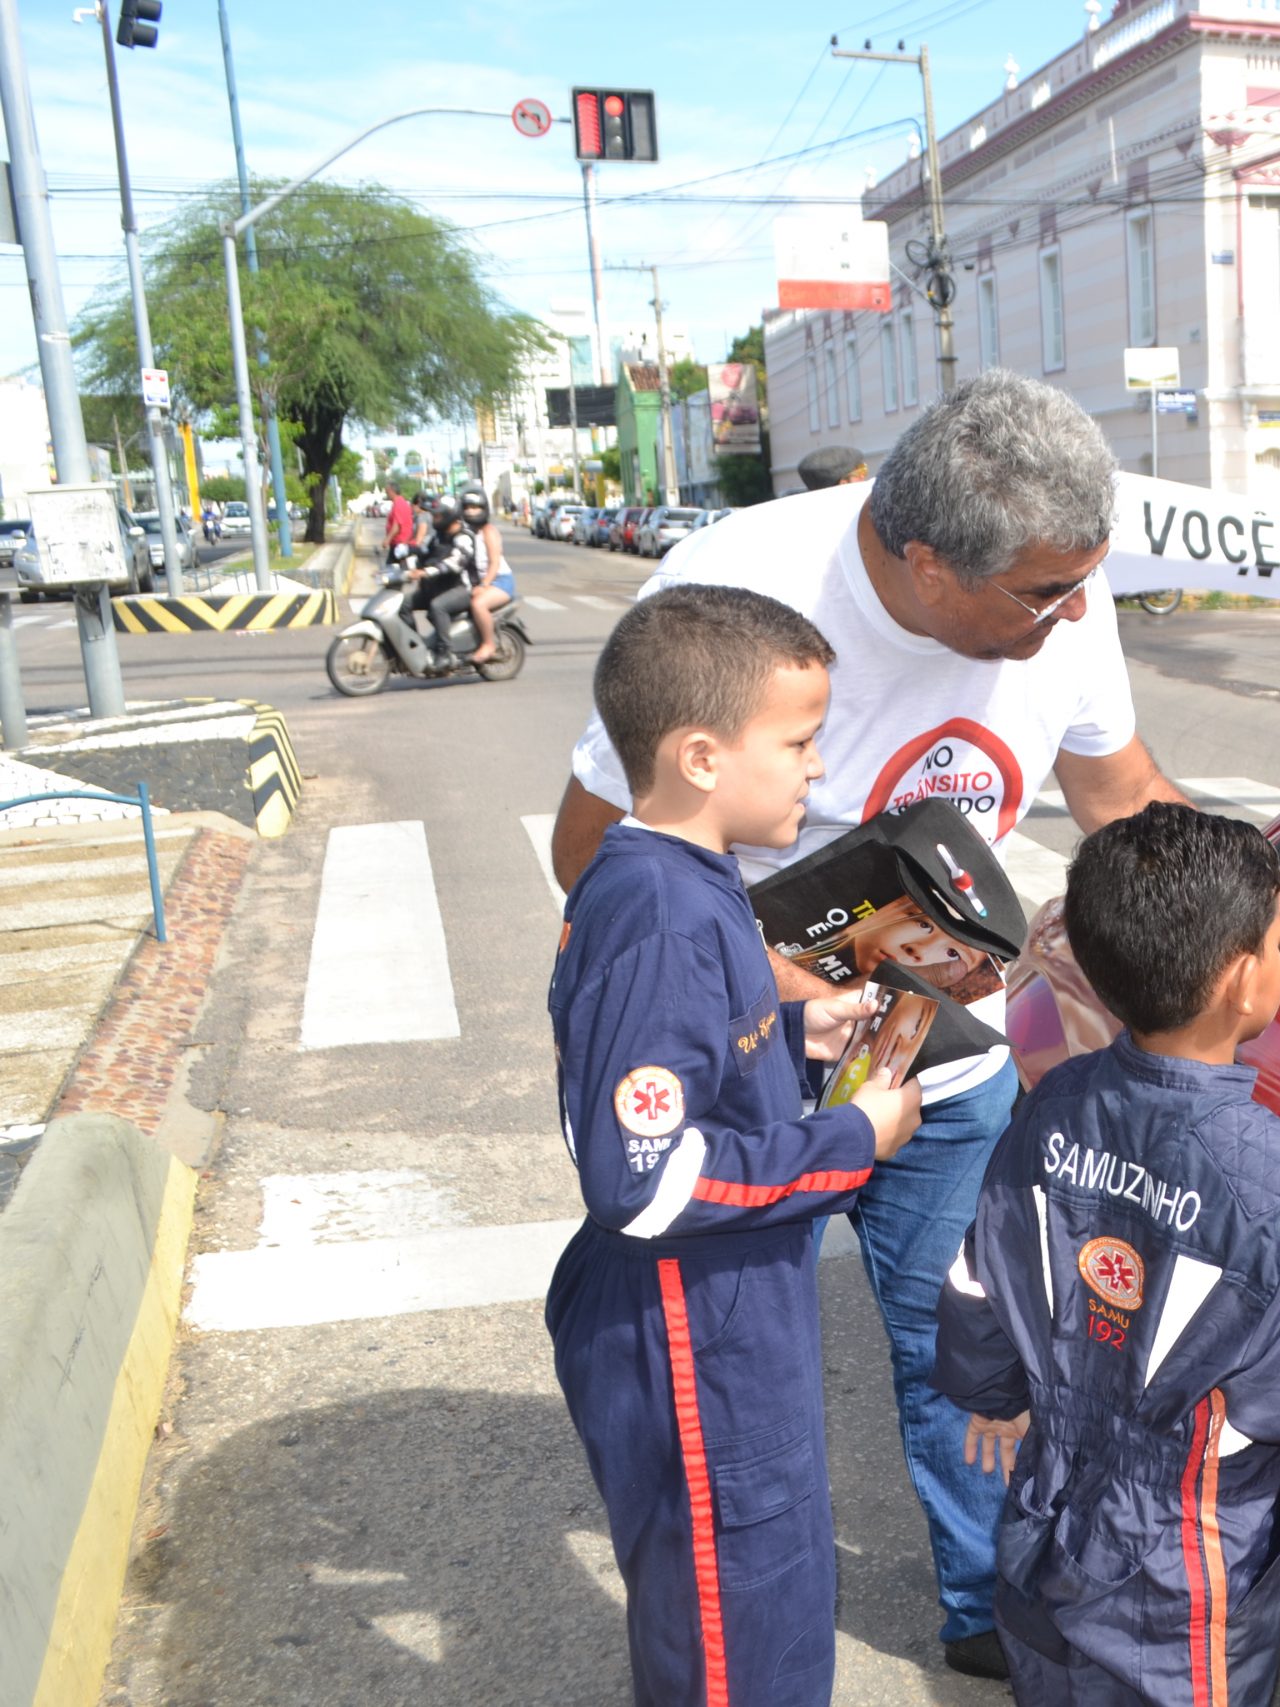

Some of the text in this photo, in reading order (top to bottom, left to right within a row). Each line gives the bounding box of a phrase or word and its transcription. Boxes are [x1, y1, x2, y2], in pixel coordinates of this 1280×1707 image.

[1143, 501, 1280, 568] VOCÊ
[922, 745, 954, 775] NO
[817, 954, 853, 982] ME
[629, 1152, 661, 1173] 19
[1043, 1131, 1202, 1232] SAMUZINHO
[1087, 1297, 1131, 1329] SAMU
[1087, 1313, 1128, 1350] 192
